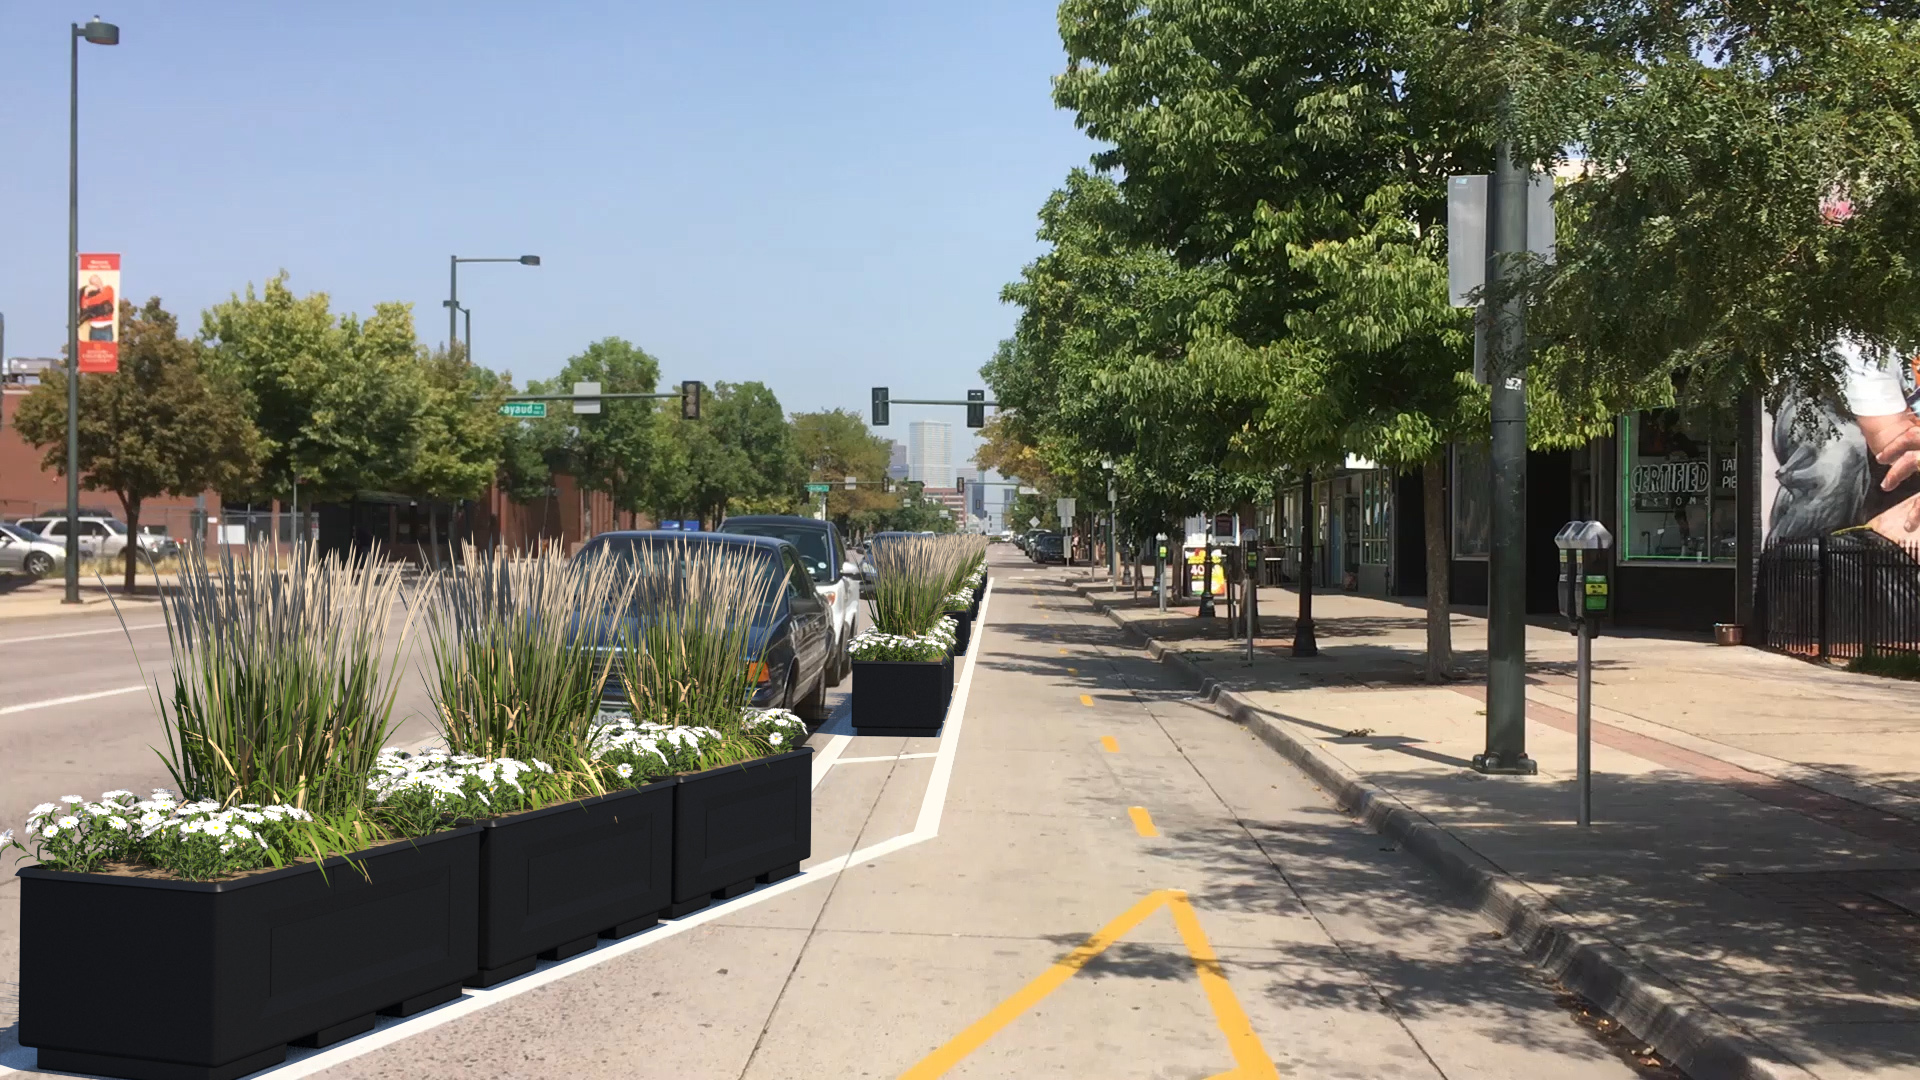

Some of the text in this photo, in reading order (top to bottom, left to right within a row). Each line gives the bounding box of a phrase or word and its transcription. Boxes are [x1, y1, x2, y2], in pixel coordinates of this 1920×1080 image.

[499, 404, 533, 416] ayaud
[1631, 462, 1709, 493] CERTIFIED
[1630, 496, 1709, 506] CUSTOMS
